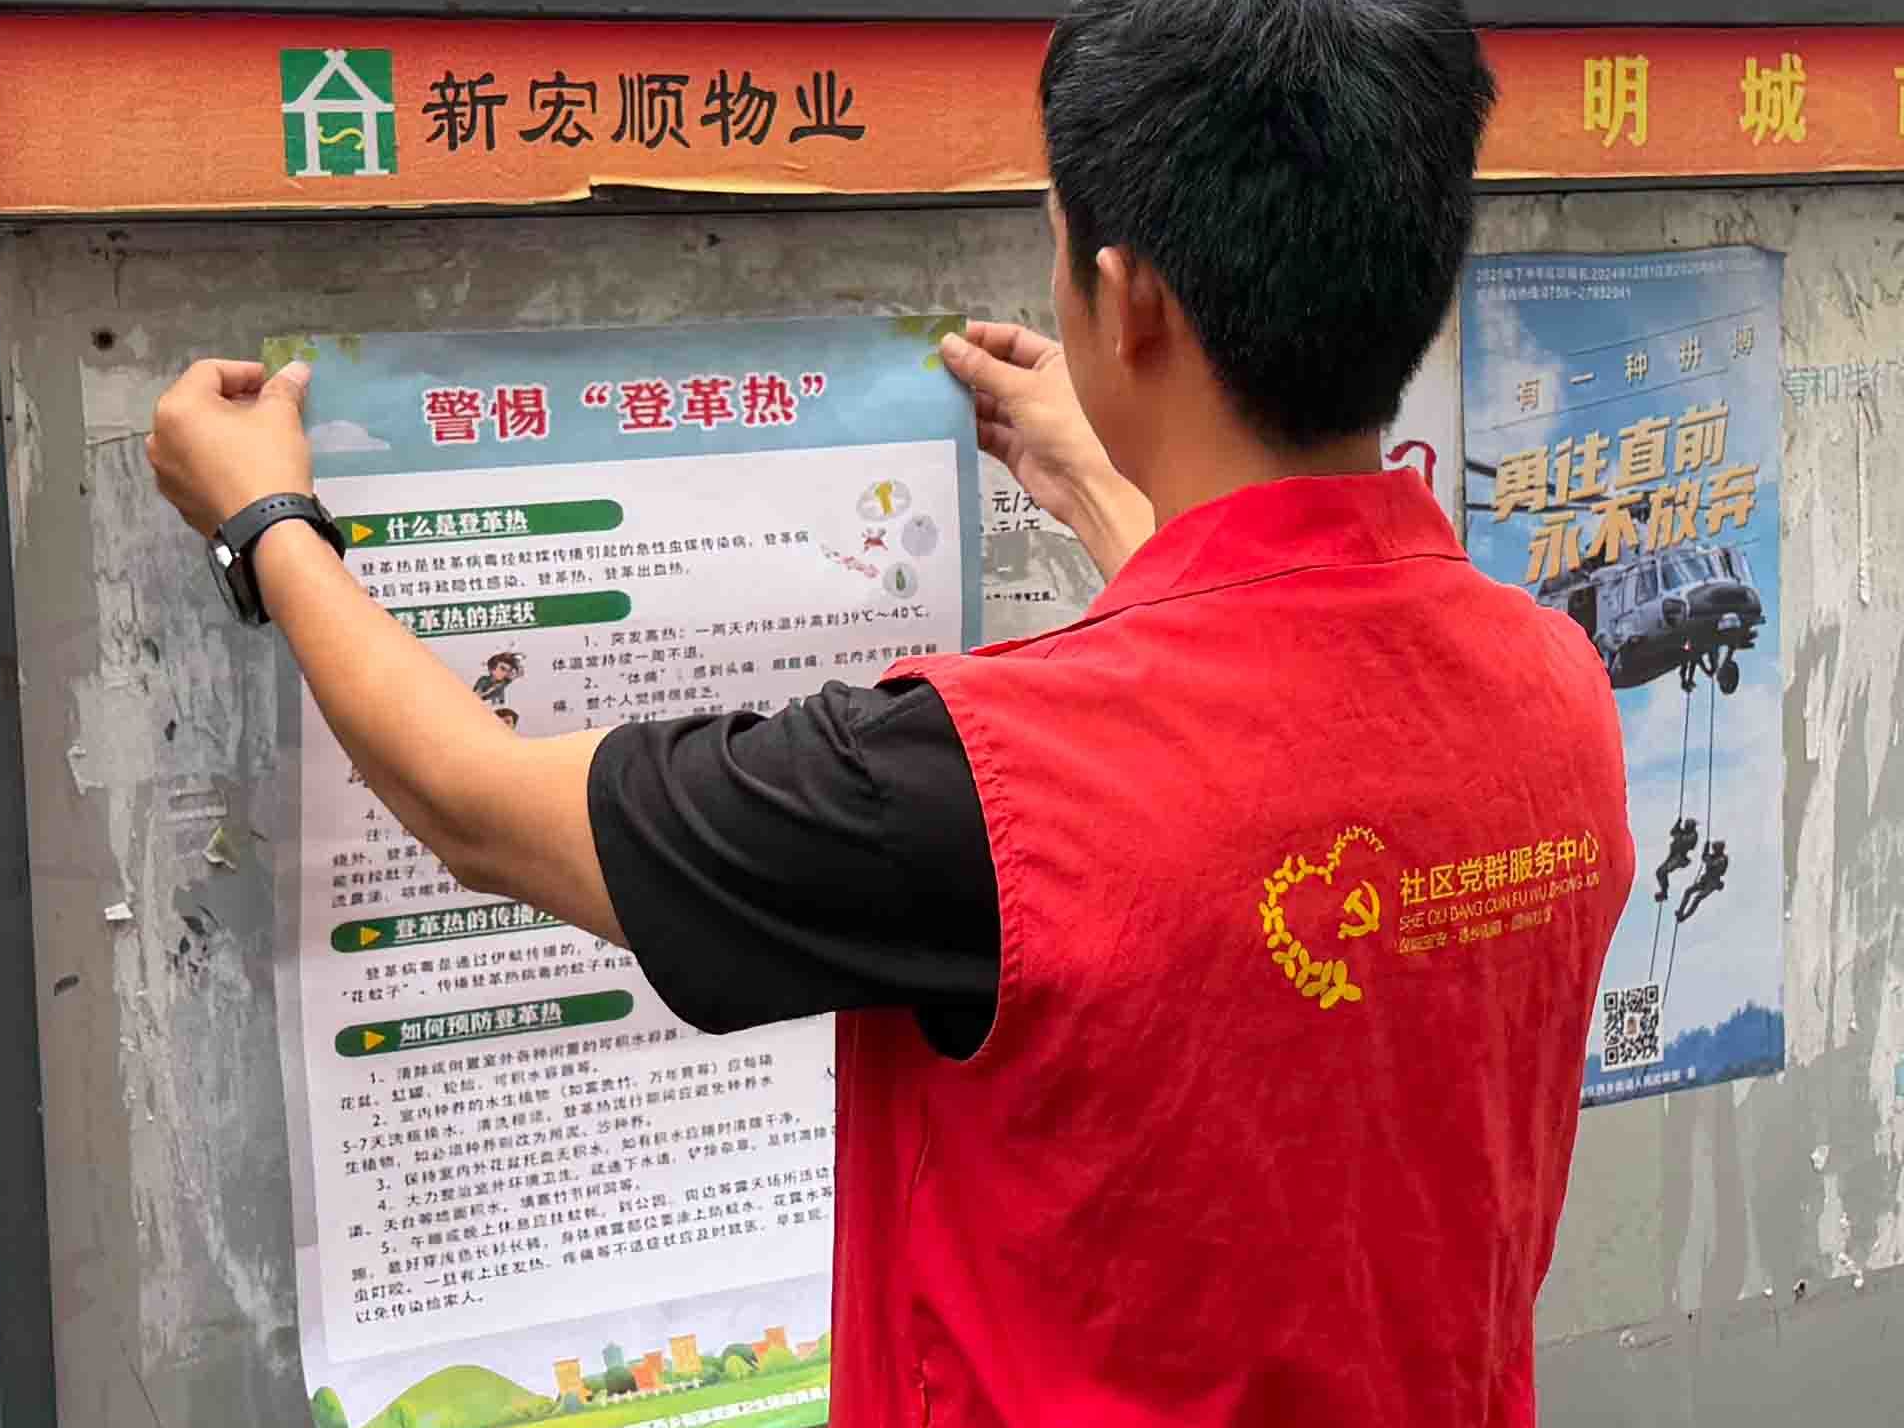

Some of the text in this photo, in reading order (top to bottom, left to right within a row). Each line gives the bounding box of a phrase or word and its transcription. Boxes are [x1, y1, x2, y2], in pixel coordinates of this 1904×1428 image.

[421, 69, 867, 151] 新宏顺物业
[1494, 398, 1729, 523] 勇往直前
[386, 508, 529, 540] 什么是登革热
[1524, 462, 1760, 583] 永不放弃
[1399, 829, 1599, 908] 社区党群服务中心
[395, 906, 554, 941] 登革热的传播
[399, 1002, 563, 1044] 如何预防登革热
